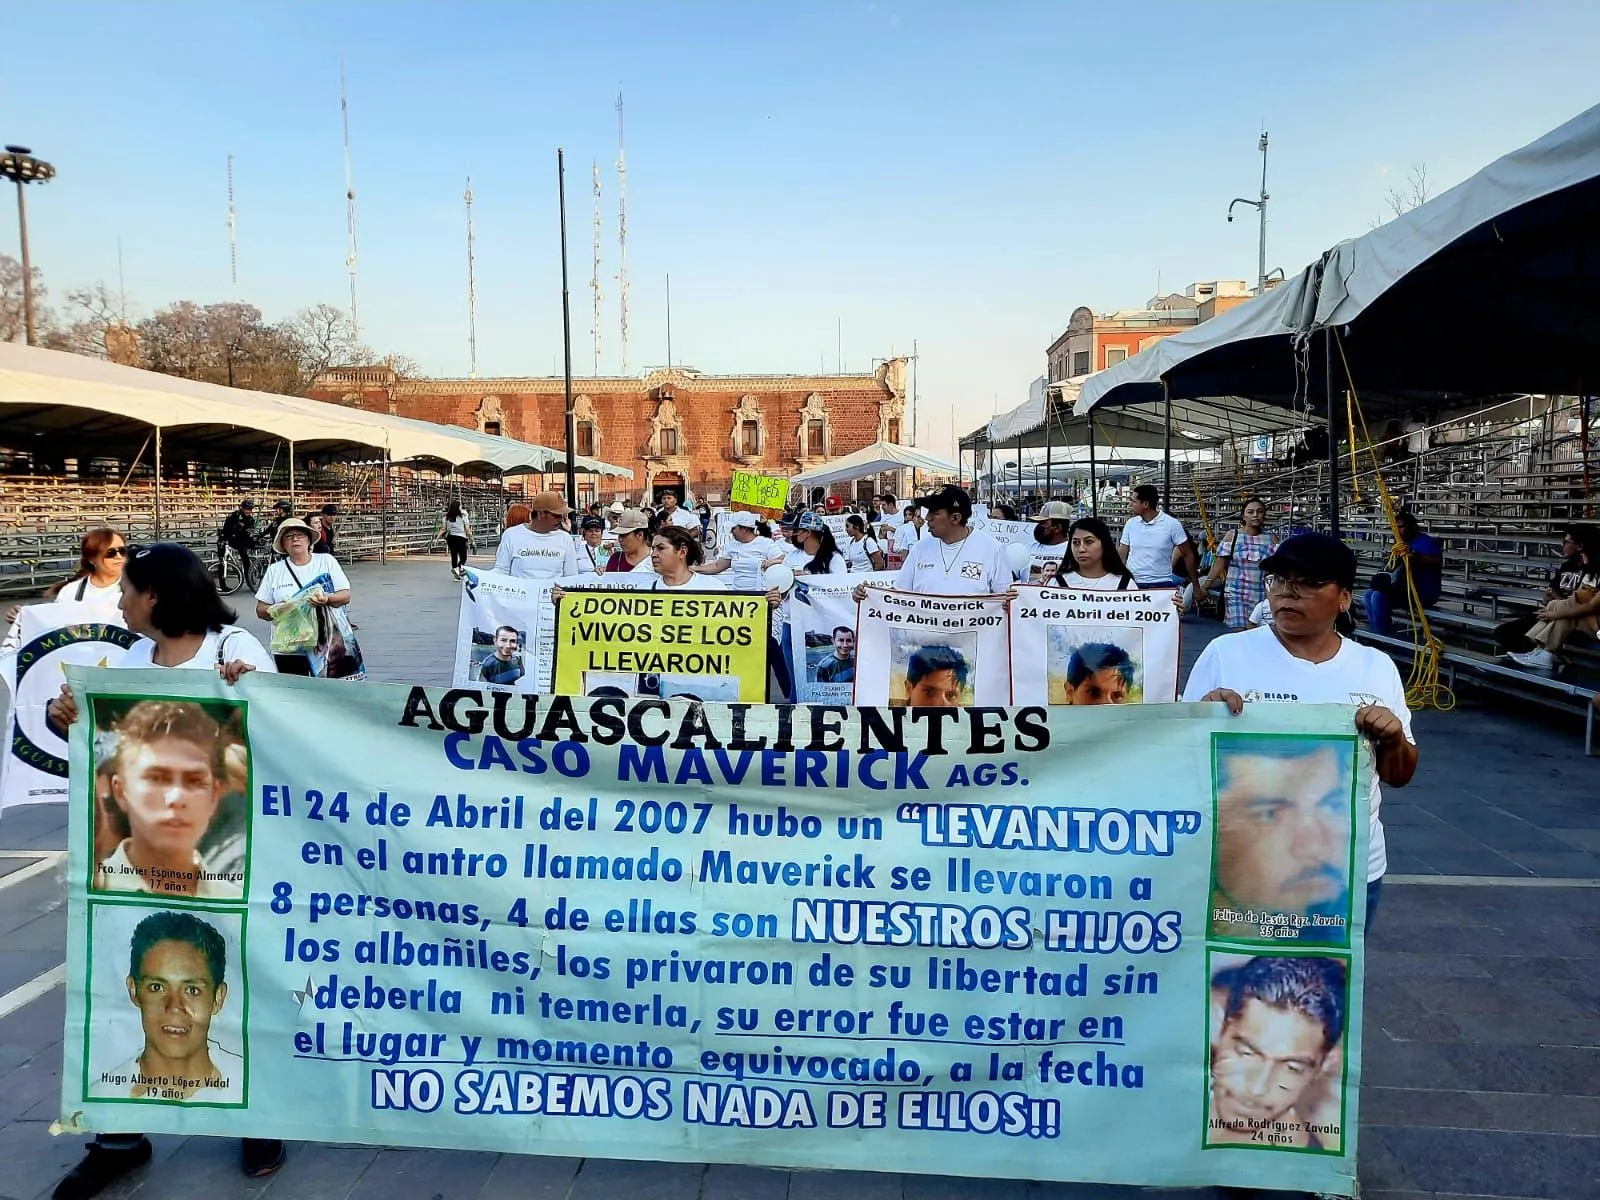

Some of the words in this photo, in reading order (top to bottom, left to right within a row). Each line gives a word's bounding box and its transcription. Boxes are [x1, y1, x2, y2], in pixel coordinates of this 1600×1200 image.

[883, 595, 915, 608] Caso
[921, 598, 984, 611] Maverick
[1039, 590, 1077, 602] Caso
[1082, 591, 1151, 603] Maverick
[570, 598, 664, 619] ¿DONDE
[671, 601, 759, 619] ESTAN?
[868, 608, 882, 620] 24
[885, 610, 902, 623] de
[906, 613, 938, 626] Abril
[942, 616, 964, 628] del
[968, 615, 1003, 627] 2007
[1021, 608, 1037, 619] 24
[1041, 608, 1061, 619] de
[1067, 608, 1101, 620] Abril
[1106, 609, 1129, 621] del
[1136, 610, 1171, 622] 2007
[571, 622, 653, 646] ¡VIVOS
[660, 624, 695, 645] SE
[701, 625, 753, 646] LOS
[588, 651, 731, 675] LLEVARON!
[398, 686, 1050, 755] AGUASCALIENTES
[444, 731, 590, 778] CASO
[617, 744, 930, 790] MAVERICK
[945, 761, 1030, 789] AGS.
[262, 784, 291, 817] El
[305, 790, 350, 824] 24
[365, 791, 410, 828] de
[426, 794, 524, 830] Abril
[540, 797, 597, 832] del
[613, 799, 714, 835] 2007
[728, 804, 822, 841] hubo
[837, 813, 883, 841] un
[119, 864, 148, 878] Javier
[151, 866, 193, 883] Espinosa
[196, 869, 243, 882] Almanza
[301, 840, 343, 867] en
[357, 839, 388, 872] el
[402, 848, 508, 879] antro
[523, 843, 682, 883] llamado
[699, 849, 876, 890] Maverick
[890, 865, 932, 892] se
[947, 857, 1112, 901] llevaron
[1129, 873, 1152, 900] a
[149, 879, 161, 890] 17
[163, 879, 188, 892] años
[269, 882, 293, 914] 8
[310, 891, 491, 932] personas,
[507, 897, 528, 928] 4
[544, 896, 590, 932] de
[604, 898, 697, 937] ellas
[711, 911, 778, 939] son
[791, 897, 1032, 950] NUESTROS
[1044, 908, 1182, 956] HIJOS
[1213, 908, 1243, 923] Felipe
[1246, 910, 1258, 921] de
[1260, 909, 1288, 926] Jesús
[1312, 914, 1345, 928] Zavala
[1259, 926, 1273, 937] 35
[1275, 926, 1299, 938] años
[284, 927, 340, 964] los
[354, 930, 542, 980] albañiles,
[557, 944, 611, 979] los
[626, 950, 793, 989] privaron
[808, 953, 855, 989] de
[868, 963, 911, 989] su
[928, 958, 1088, 997] libertad
[1103, 966, 1158, 995] sin
[314, 974, 461, 1014] deberla
[491, 986, 525, 1015] ni
[539, 992, 701, 1033] temerla,
[715, 1005, 758, 1032] su
[774, 1007, 874, 1036] error
[888, 1004, 949, 1038] fue
[964, 1011, 1065, 1041] estar
[1078, 1015, 1123, 1040] en
[294, 1022, 326, 1055] el
[343, 1022, 446, 1064] lugar
[460, 1036, 483, 1066] y
[497, 1037, 673, 1069] momento
[700, 1045, 934, 1084] equivocado,
[950, 1060, 972, 1083] a
[988, 1052, 1024, 1082] la
[1038, 1054, 1144, 1088] fecha
[101, 1072, 127, 1087] Hugo
[130, 1072, 169, 1087] Alberto
[172, 1073, 200, 1090] López
[204, 1076, 230, 1089] Vidal
[146, 1087, 158, 1098] 19
[160, 1087, 185, 1100] años
[371, 1068, 444, 1113] NO
[454, 1070, 672, 1120] SABEMOS
[683, 1081, 817, 1129] NADA
[826, 1088, 886, 1130] DE
[898, 1090, 1061, 1138] ELLOS!!
[1208, 1118, 1244, 1131] Alfredo
[1247, 1117, 1301, 1134] Rodríguez
[1305, 1121, 1340, 1134] Zavala
[1251, 1131, 1263, 1142] 24
[1268, 1131, 1293, 1143] años
